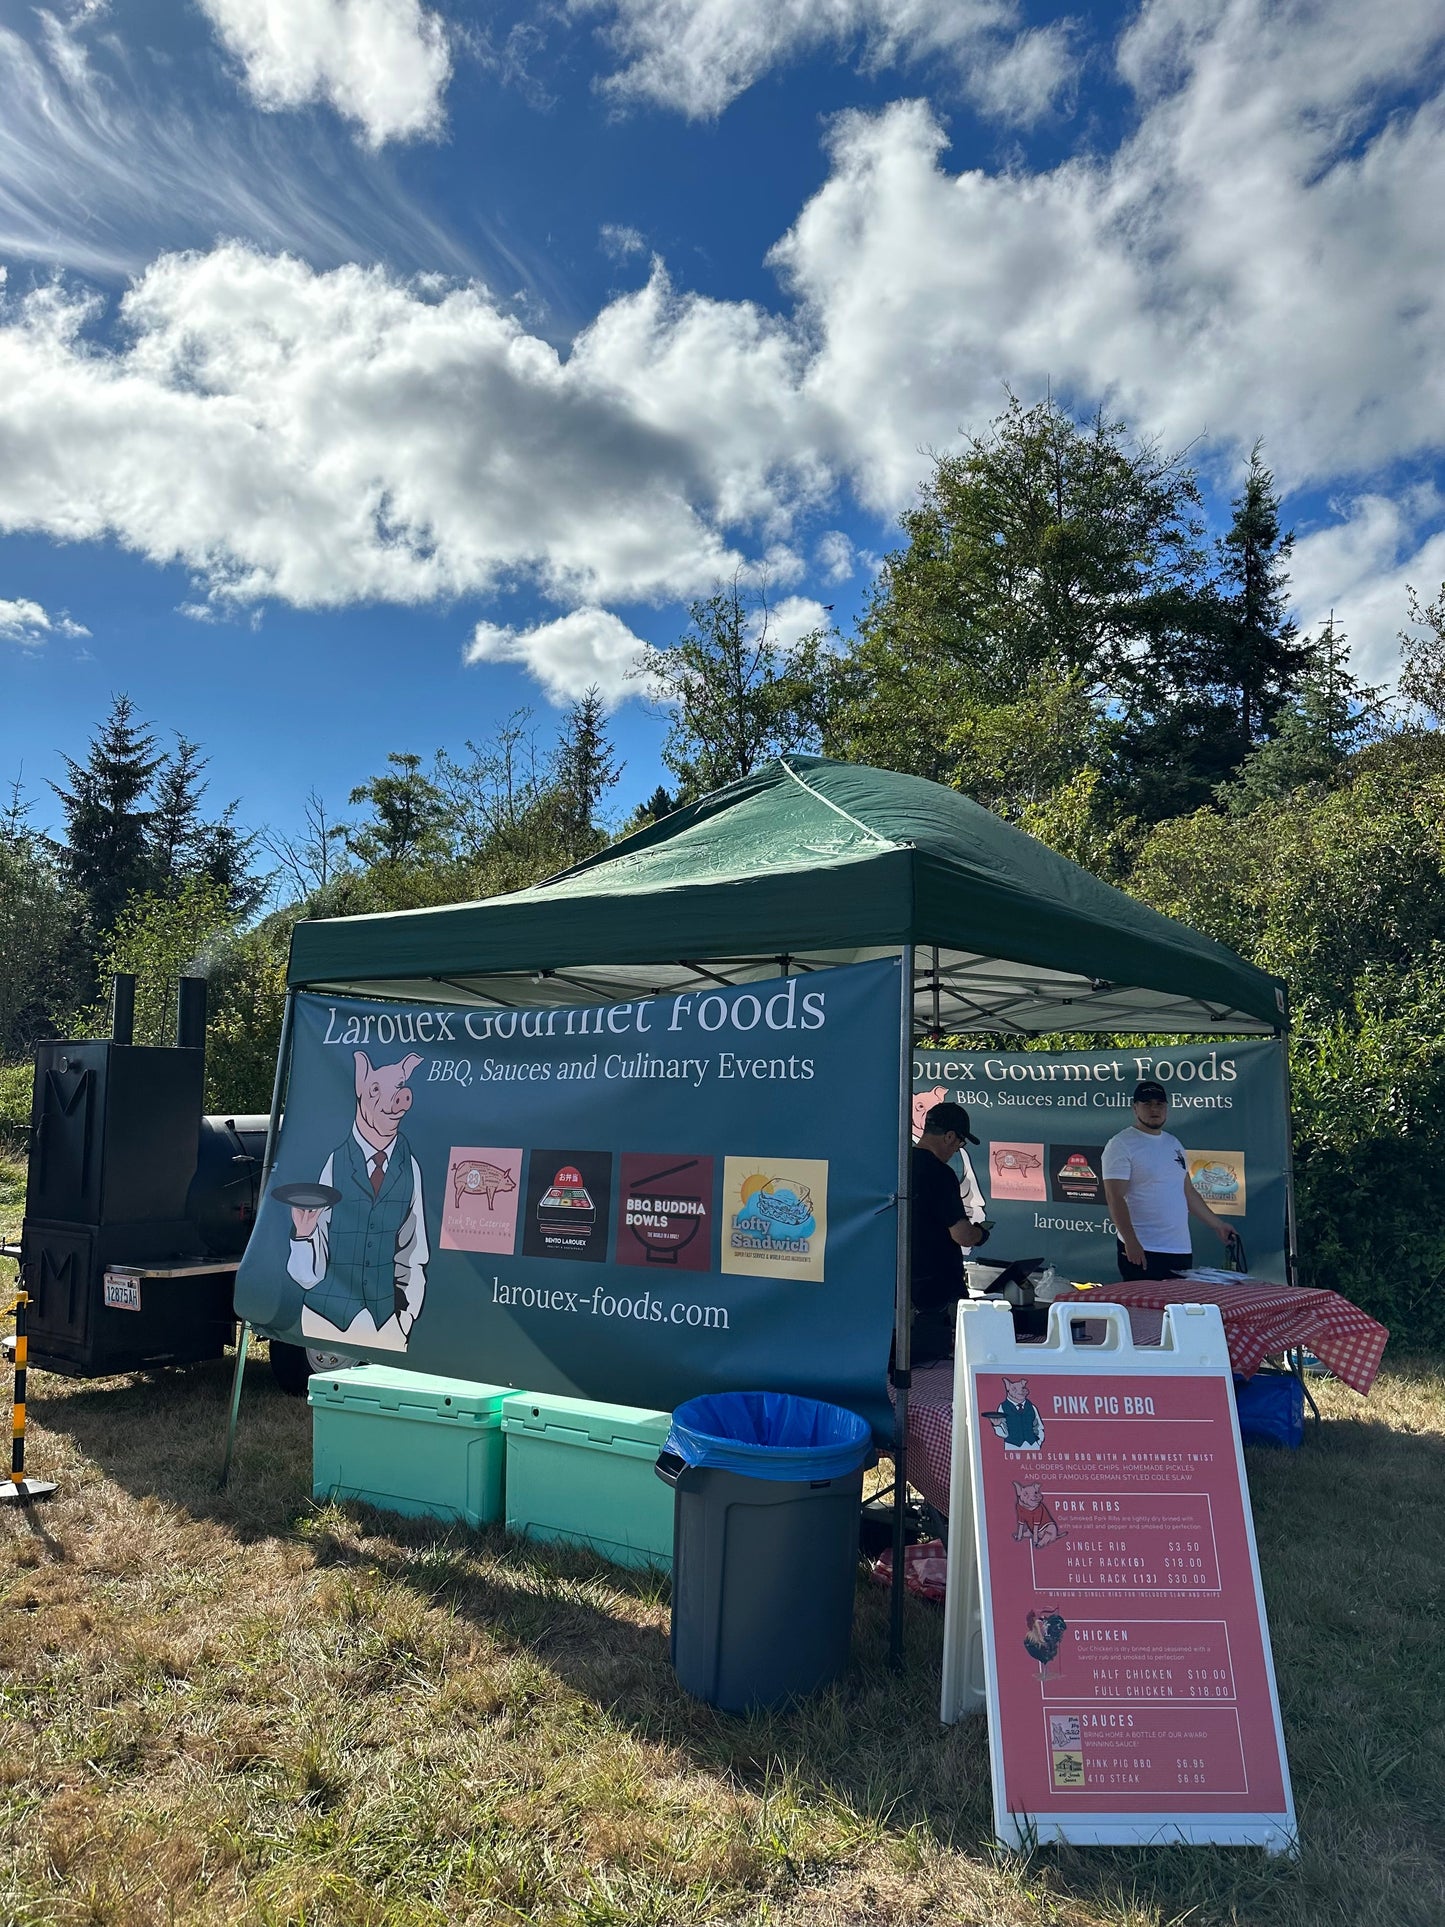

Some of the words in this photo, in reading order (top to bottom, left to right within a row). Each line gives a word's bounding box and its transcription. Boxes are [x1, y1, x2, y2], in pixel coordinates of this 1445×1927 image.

[323, 1007, 455, 1045] Larouex
[464, 1001, 655, 1040] Gourmet
[667, 978, 826, 1031] Foods
[427, 1060, 473, 1086] BBQ,
[480, 1058, 551, 1082] Sauces
[557, 1054, 597, 1080] and
[604, 1053, 710, 1088] Culinary
[718, 1052, 815, 1080] Events
[912, 1061, 976, 1080] ouex
[984, 1059, 1126, 1082] Gourmet
[1133, 1051, 1238, 1082] Foods
[956, 1090, 993, 1108] BBQ,
[997, 1091, 1053, 1106] Sauces
[1057, 1092, 1088, 1107] and
[1171, 1092, 1233, 1109] Events
[626, 1198, 652, 1211] BBQ
[655, 1200, 706, 1215] BUDDHA
[625, 1213, 668, 1228] BOWLS
[731, 1214, 770, 1234] Lofty
[1034, 1212, 1118, 1235] larouex-fo
[545, 1236, 561, 1244] BENTO
[562, 1238, 587, 1246] LAROUEX
[731, 1234, 810, 1253] Sandwich
[492, 1276, 730, 1329] larouex-foods.com
[1053, 1395, 1090, 1414] PINK
[1094, 1396, 1118, 1415] PIG
[1124, 1396, 1155, 1416] BBQ
[1004, 1452, 1021, 1461] LOW
[1026, 1452, 1043, 1461] AND
[1047, 1452, 1070, 1461] SLOW
[1074, 1453, 1092, 1461] BBQ
[1096, 1453, 1118, 1461] WITH
[1122, 1453, 1127, 1461] A
[1131, 1453, 1182, 1461] NORTHWEST
[1187, 1453, 1214, 1461] TWIST
[1165, 1464, 1195, 1472] PICKLES
[1054, 1500, 1085, 1511] PORK
[1092, 1500, 1120, 1512] RIBS
[1066, 1541, 1103, 1551] SINGLE
[1109, 1542, 1127, 1551] RIB
[1168, 1542, 1200, 1552] $3.50
[1067, 1557, 1094, 1567] HALF
[1164, 1558, 1202, 1568] $18.00
[1069, 1574, 1094, 1584] FULL
[1100, 1574, 1127, 1584] RACK
[1167, 1574, 1206, 1584] $30.00
[1074, 1629, 1128, 1641] CHICKEN
[1093, 1669, 1120, 1680] HALF
[1126, 1669, 1173, 1680] CHICKEN
[1187, 1670, 1226, 1680] $10.00
[1094, 1686, 1120, 1696] FULL
[1126, 1686, 1173, 1696] CHICKEN
[1189, 1686, 1229, 1696] $18.00
[1082, 1714, 1134, 1727] SAUCES
[1086, 1759, 1108, 1768] PINK
[1113, 1759, 1129, 1768] PIG
[1134, 1759, 1151, 1768] BBQ
[1177, 1759, 1205, 1769] $6.95
[1088, 1774, 1105, 1783] 410
[1110, 1774, 1140, 1783] STEAK
[1177, 1774, 1206, 1784] $6.95
